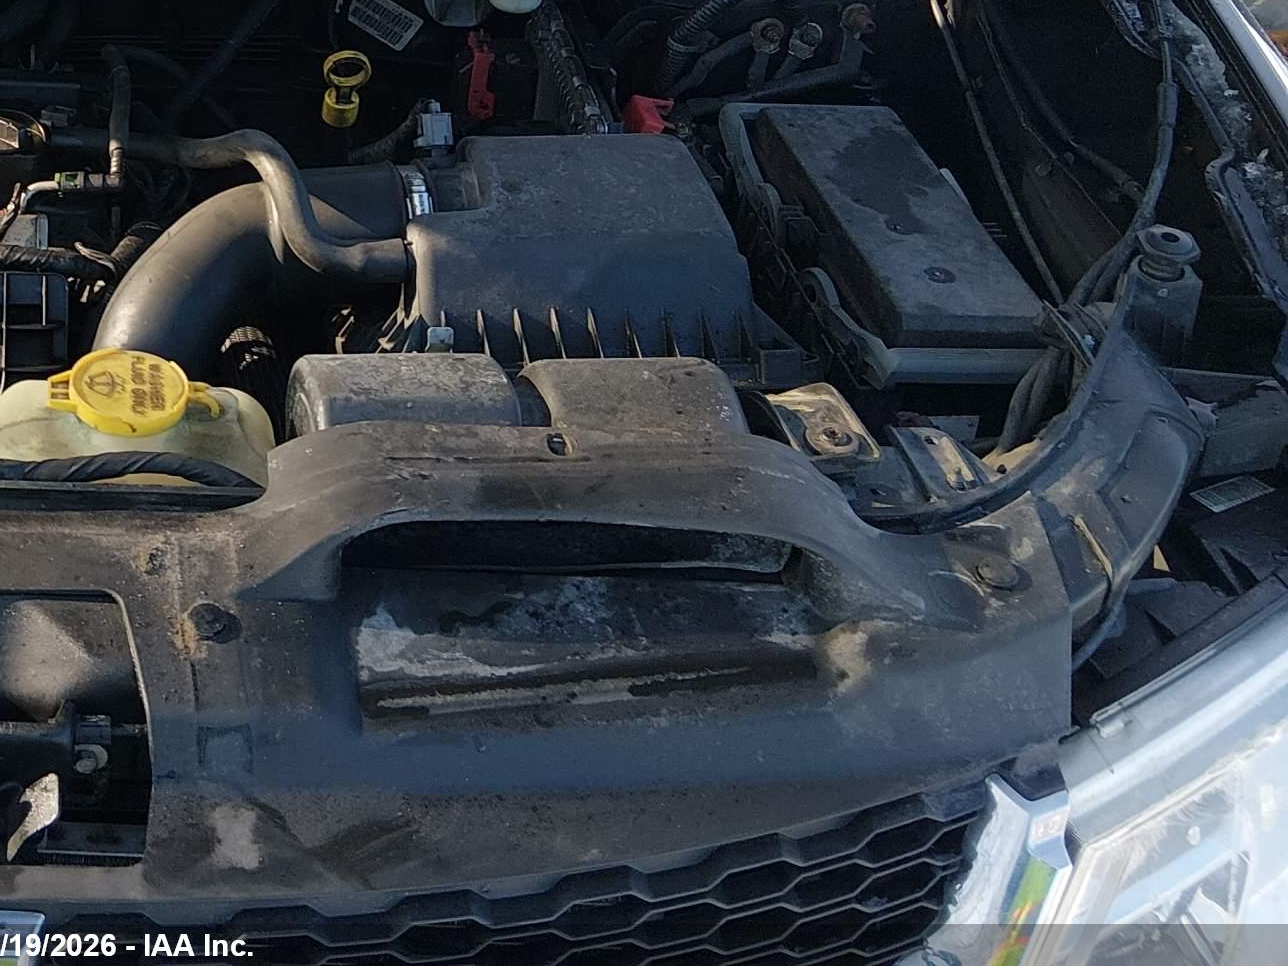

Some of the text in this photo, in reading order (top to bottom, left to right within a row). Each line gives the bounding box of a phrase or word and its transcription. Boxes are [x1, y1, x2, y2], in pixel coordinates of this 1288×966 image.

[131, 355, 148, 418] FLUID ONLY
[149, 363, 166, 412] WASHER
